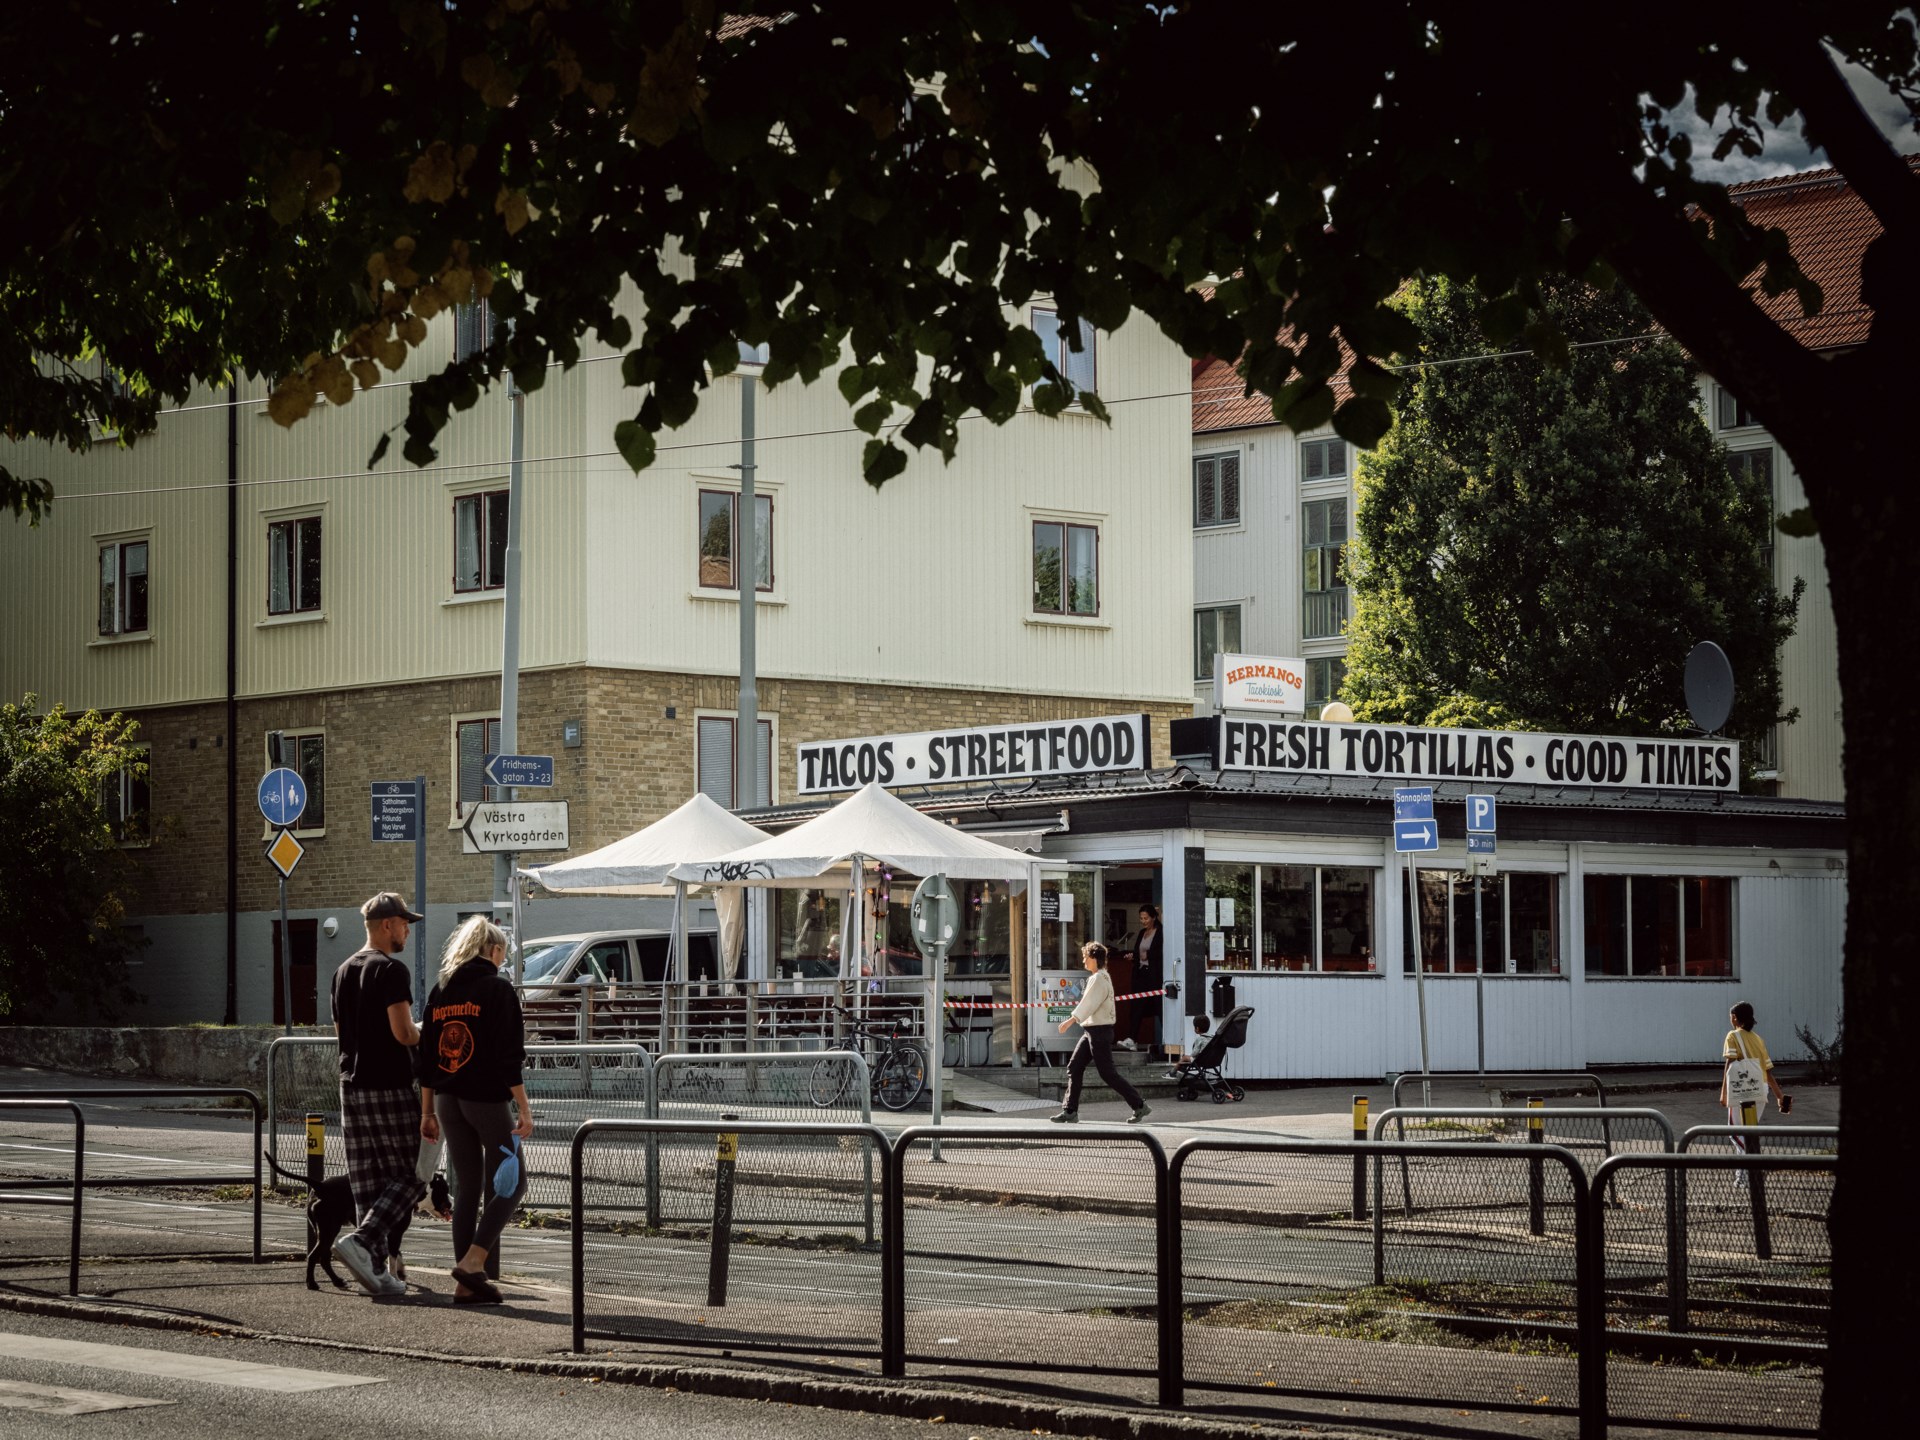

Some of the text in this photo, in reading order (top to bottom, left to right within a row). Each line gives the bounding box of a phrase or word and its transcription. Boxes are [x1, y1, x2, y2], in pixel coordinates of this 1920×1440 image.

[1226, 664, 1303, 690] HERMANOS
[1245, 682, 1284, 697] Tacokiosk
[800, 722, 1136, 789] TACOS STREETFOOD
[1224, 721, 1732, 788] FRESH TORTILLAS GOOD TIMES
[502, 758, 542, 771] Fridhems-
[502, 773, 526, 784] gatan
[1395, 792, 1432, 804] Sannaplan
[484, 810, 526, 824] Västra
[1396, 806, 1402, 816] 4
[1474, 798, 1489, 828] P
[382, 823, 392, 831] Nya
[382, 832, 404, 840] Kungsten
[483, 829, 565, 846] Kyrkogården
[1469, 838, 1493, 849] 30 min
